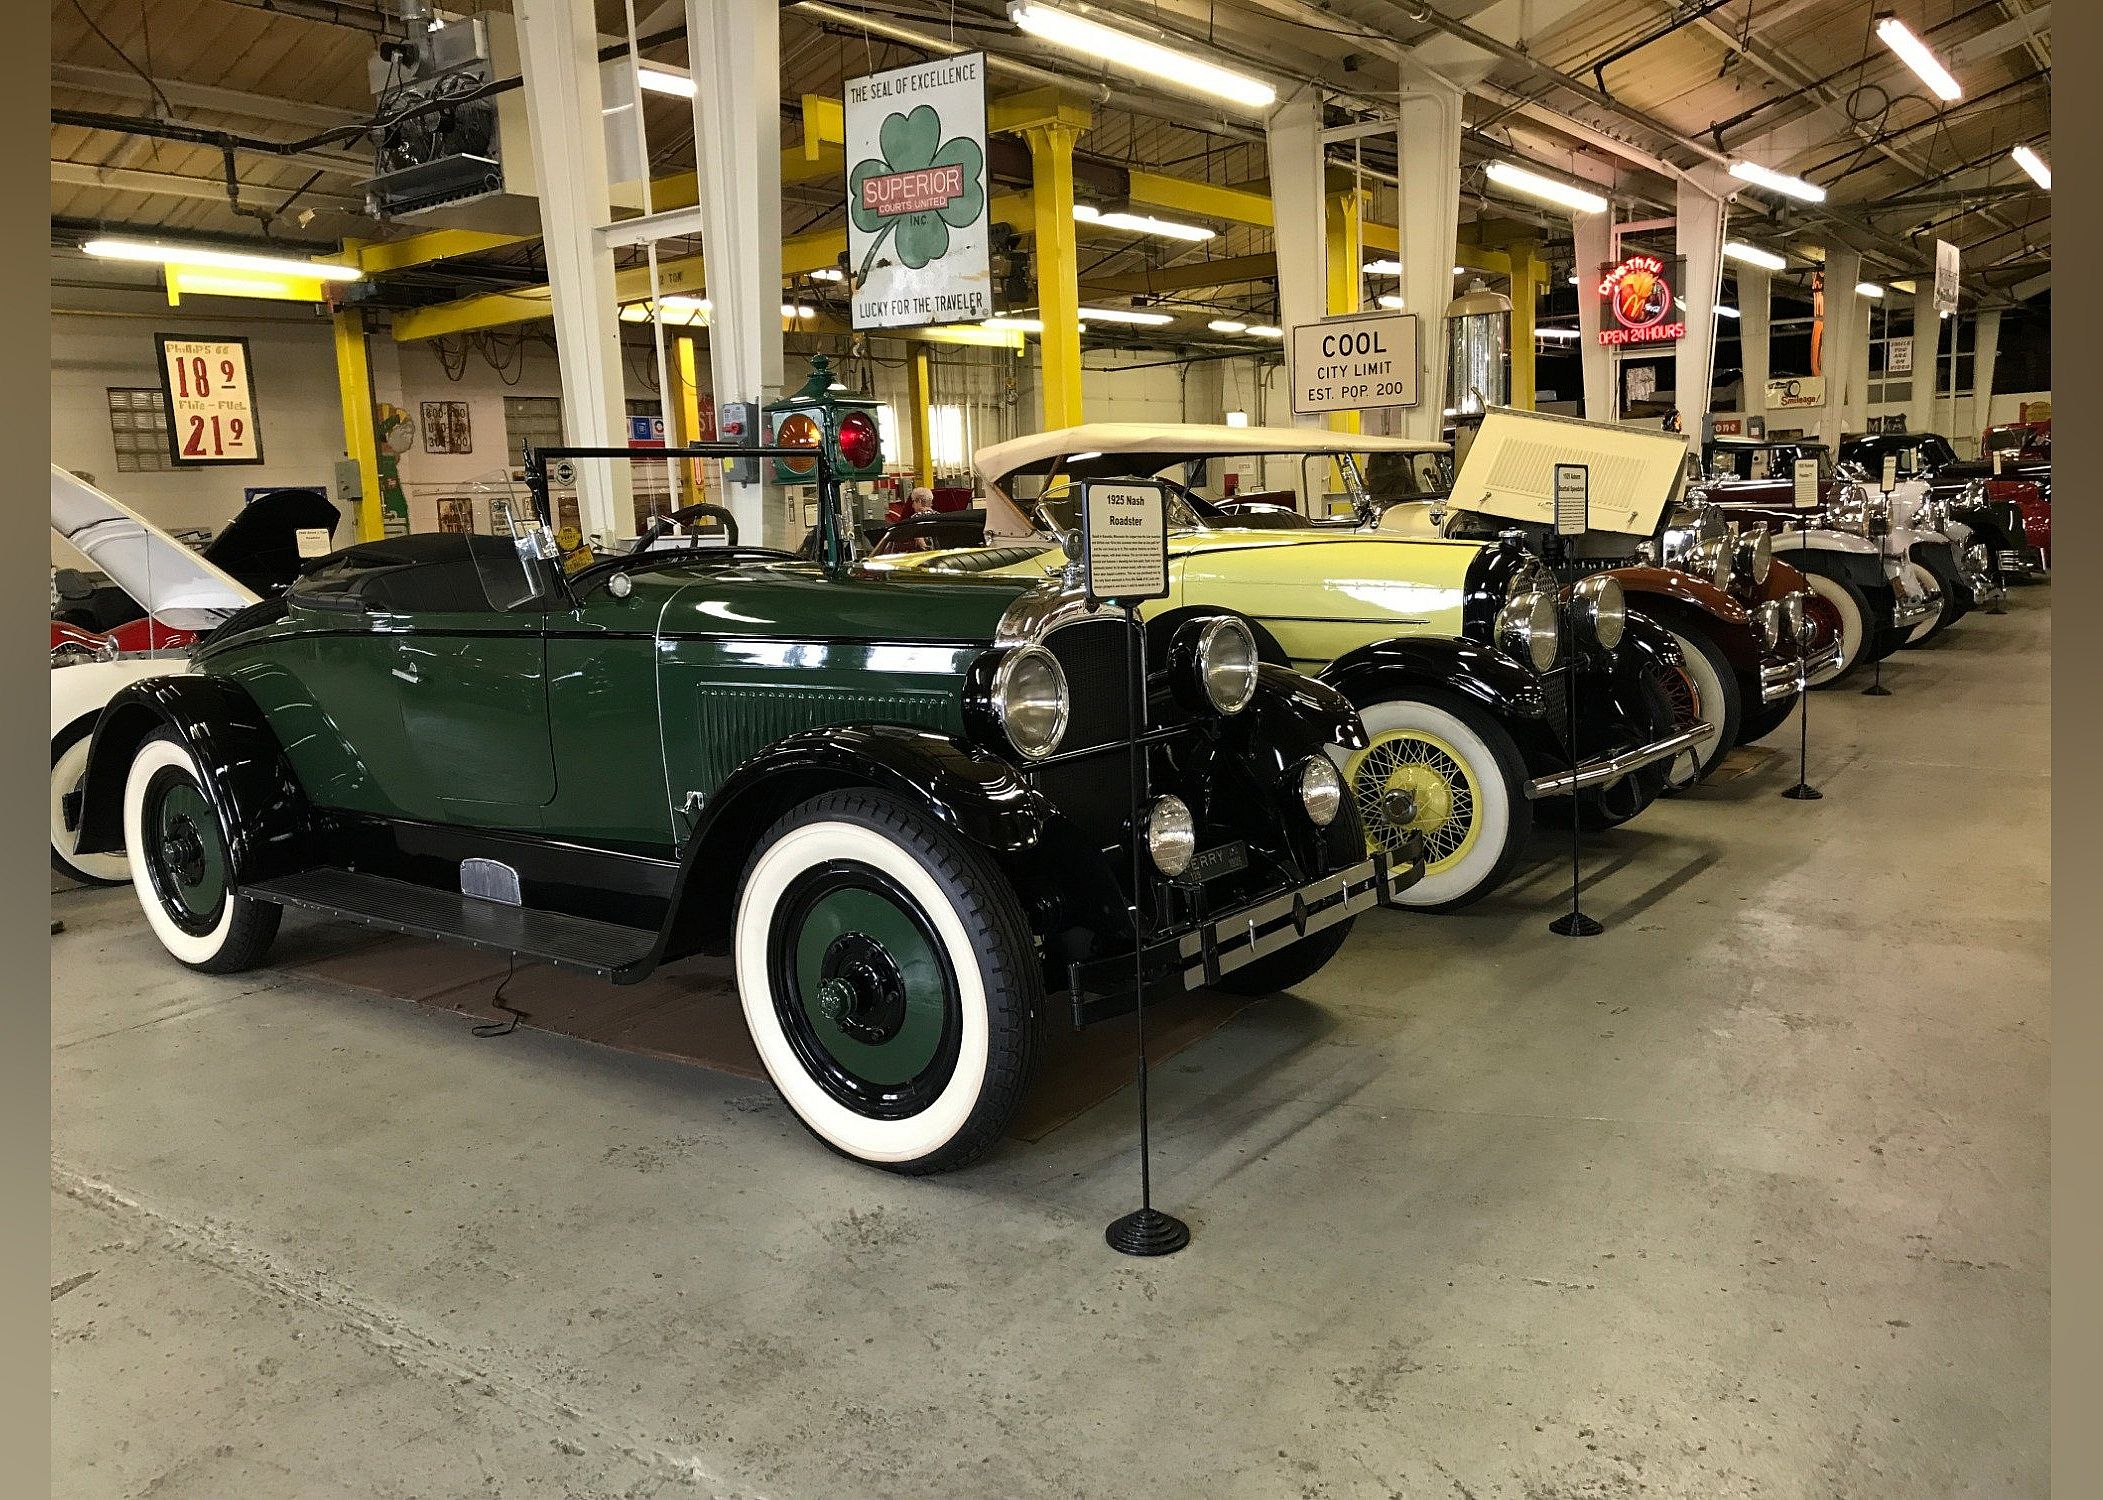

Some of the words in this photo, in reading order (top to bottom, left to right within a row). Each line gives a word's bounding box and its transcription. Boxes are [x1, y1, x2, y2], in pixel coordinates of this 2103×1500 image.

[850, 85, 868, 104] THE
[871, 81, 893, 99] SEAL
[895, 77, 909, 94] OF
[911, 63, 976, 91] EXCELLENCE
[865, 169, 960, 203] SUPERIOR
[878, 200, 912, 214] COURTS
[914, 196, 946, 210] UNITED
[859, 300, 888, 319] LUCKY
[891, 299, 910, 316] FOR
[914, 296, 932, 313] THE
[934, 291, 984, 312] TRAVELER
[1322, 331, 1387, 358] COOL
[1598, 330, 1629, 345] OPEN
[1630, 328, 1645, 342] 24
[1645, 323, 1685, 341] HOURS
[175, 356, 210, 398] 18
[1317, 364, 1348, 380] CITY
[1354, 360, 1392, 377] LIMIT
[1308, 387, 1334, 401] EST.
[1341, 384, 1369, 399] POP.
[1376, 381, 1403, 396] 200
[182, 414, 224, 456] 21
[1107, 494, 1125, 505] 1925
[1126, 495, 1145, 506] Nash
[1109, 515, 1143, 527] Roadster
